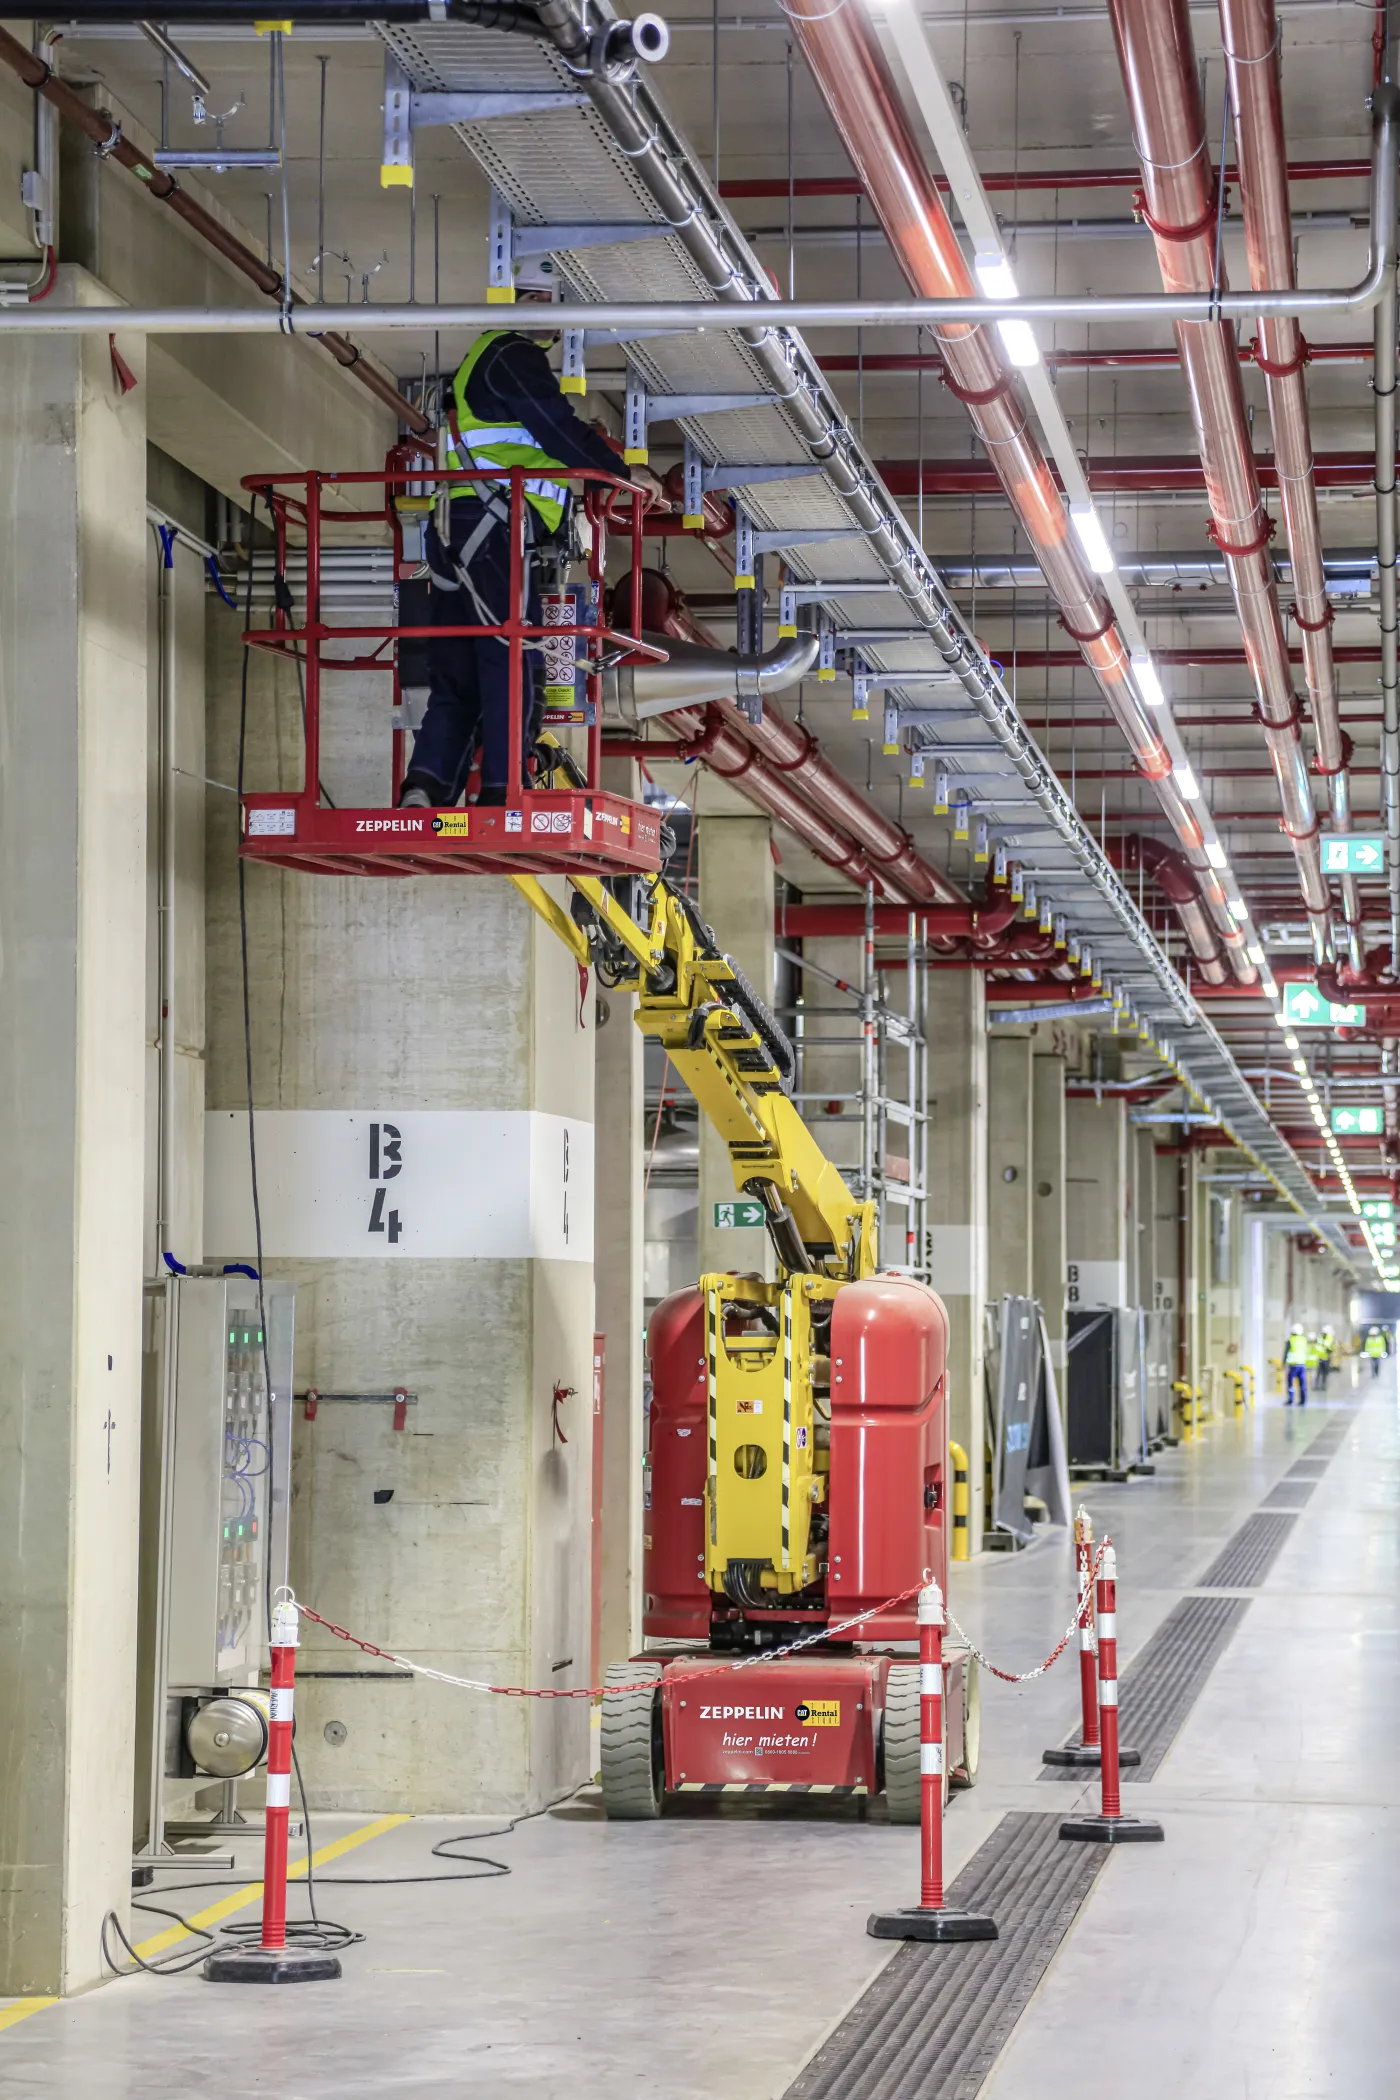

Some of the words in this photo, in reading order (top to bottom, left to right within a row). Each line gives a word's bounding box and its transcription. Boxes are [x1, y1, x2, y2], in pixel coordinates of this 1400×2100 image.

[355, 820, 423, 832] ZEPPELIN
[369, 1123, 403, 1180] B
[368, 1187, 403, 1244] 4
[1067, 1264, 1079, 1283] B
[1067, 1285, 1080, 1303] 8
[1155, 1297, 1172, 1310] 10
[700, 1706, 784, 1720] ZEPPELIN
[722, 1732, 753, 1747] hier
[758, 1733, 809, 1747] mieten
